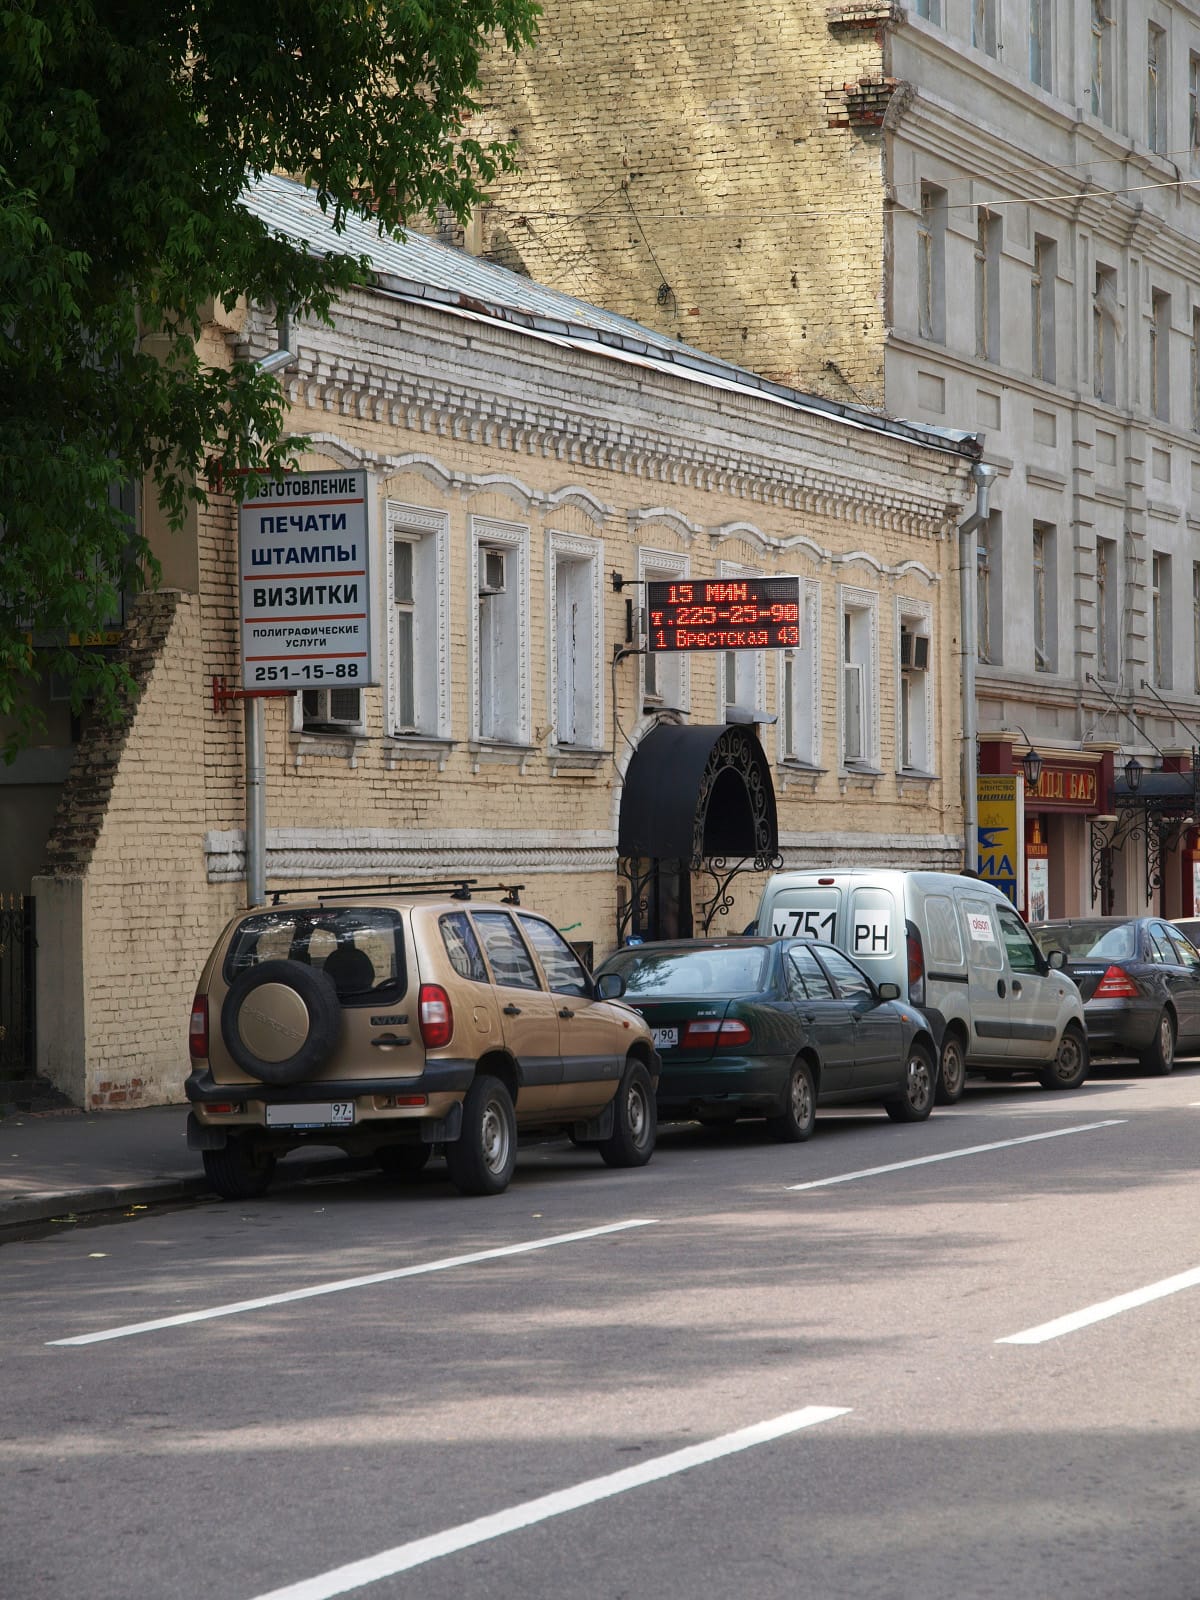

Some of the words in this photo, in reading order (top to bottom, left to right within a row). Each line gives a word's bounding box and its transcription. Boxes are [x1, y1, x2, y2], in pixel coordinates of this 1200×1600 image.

[260, 513, 347, 534] ПЕЧАТИ
[251, 544, 357, 566] ШТАМПЫ
[253, 584, 358, 608] ВИЗИТКИ
[667, 585, 693, 603] 15
[253, 625, 359, 638] ПОЛИГРАФИЧЕСКИЕ
[656, 630, 668, 647] 1
[676, 629, 769, 647] Брестская
[778, 626, 798, 644] 43
[286, 638, 327, 648] УСЛУГИ
[255, 663, 359, 681] 251-15-88
[1070, 773, 1095, 800] БАР
[661, 1029, 674, 1040] 90
[333, 1103, 348, 1116] 97
